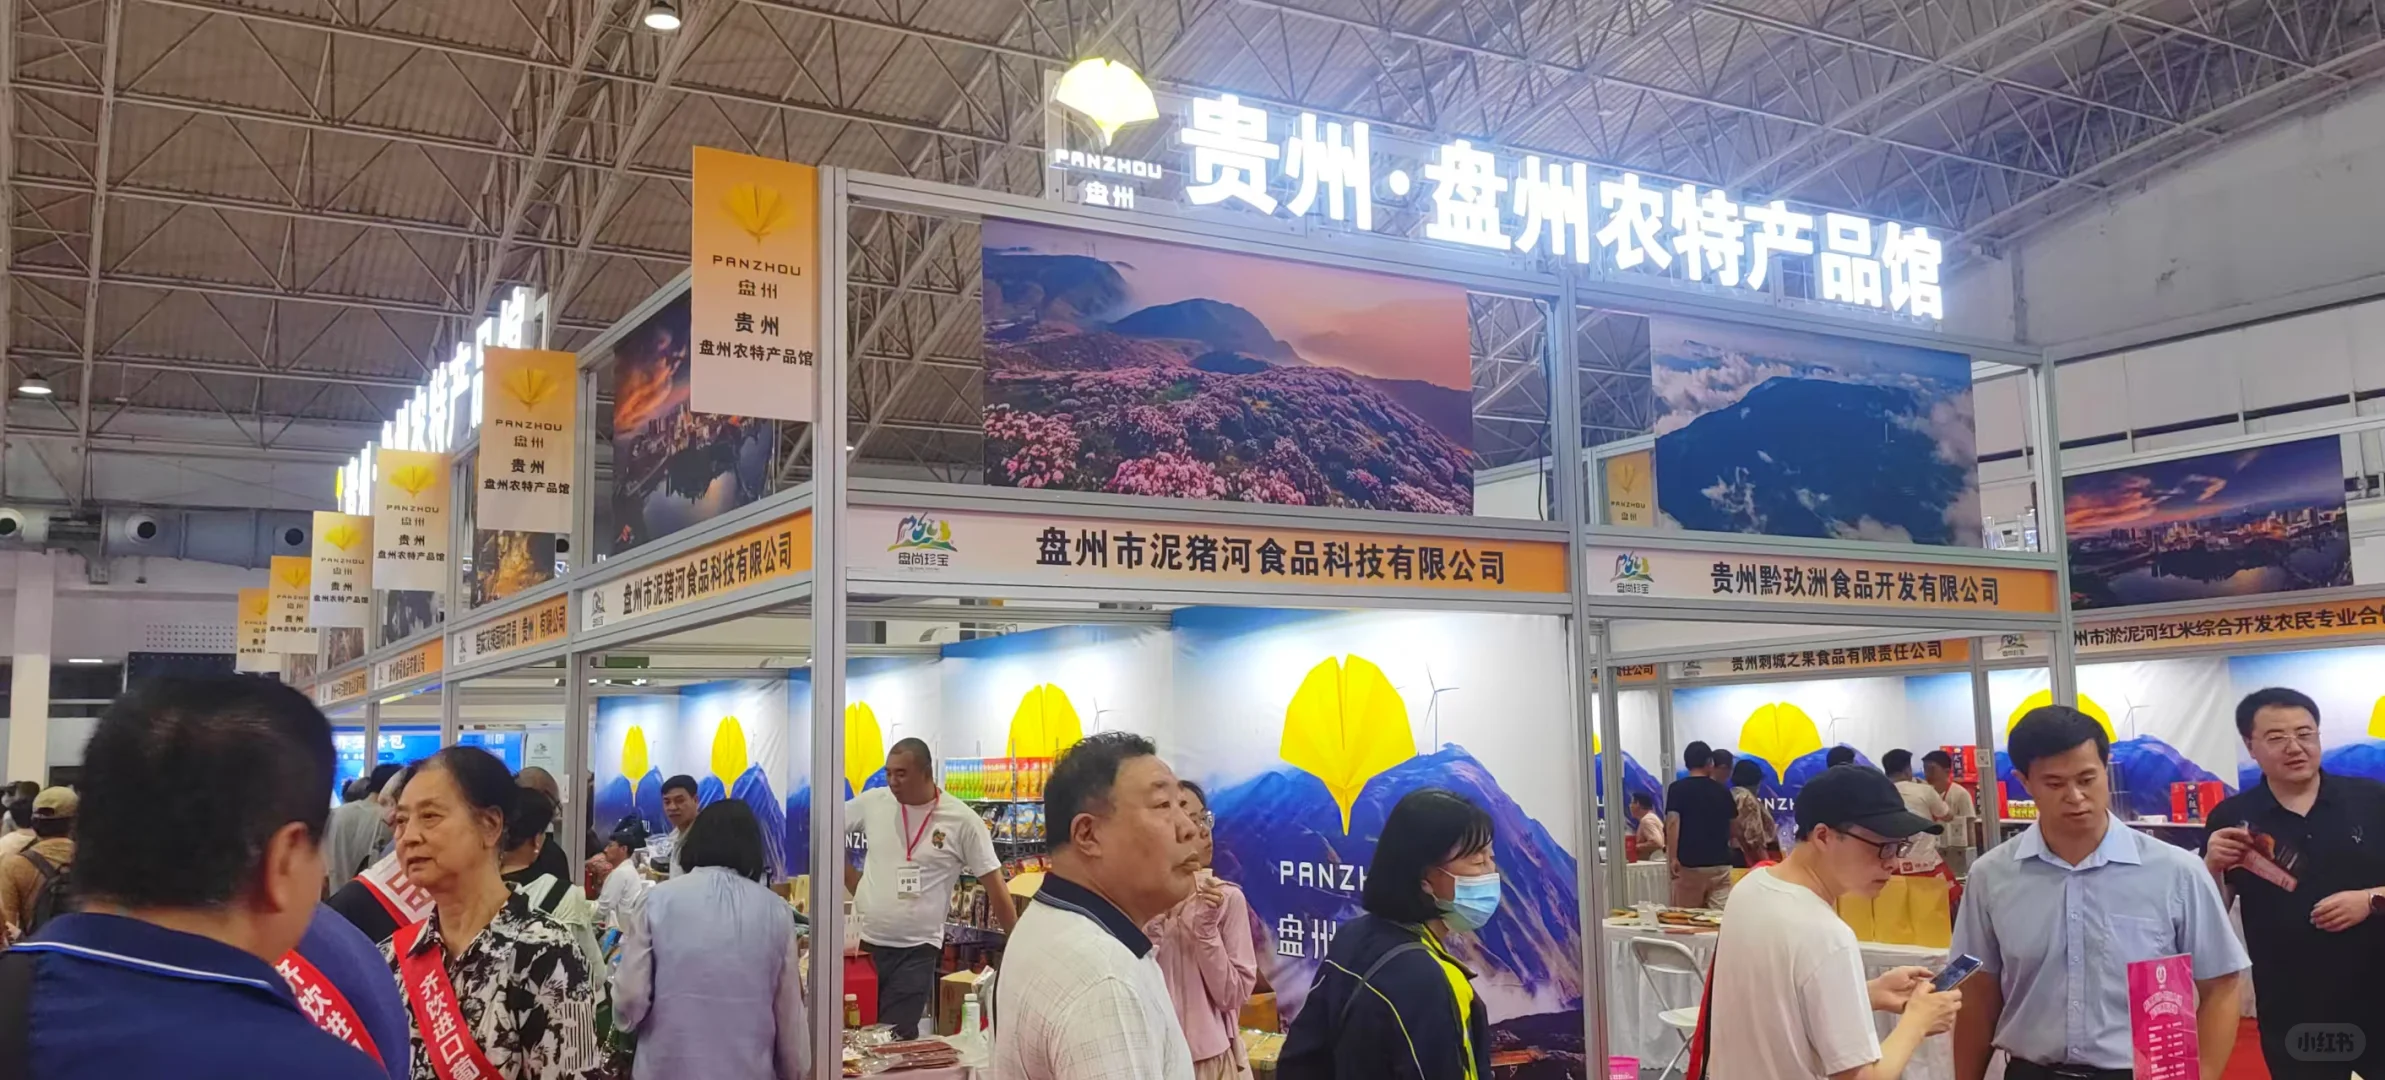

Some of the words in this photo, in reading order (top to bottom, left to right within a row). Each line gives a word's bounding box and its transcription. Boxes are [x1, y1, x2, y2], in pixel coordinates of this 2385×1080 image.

[1055, 148, 1162, 179] PANZHOU
[1085, 181, 1135, 209] 盘州
[1181, 93, 1944, 320] 贵州·盘州农特产品馆
[712, 254, 801, 277] PANZHOU
[738, 279, 778, 299] 盘州
[734, 312, 780, 337] 贵州
[699, 339, 813, 366] 盘州农特产品馆
[495, 419, 562, 432] PANZHOU
[514, 435, 544, 449] 盘州
[511, 458, 545, 475] 贵州
[483, 478, 570, 495] 盘州农特产品馆
[386, 504, 440, 513] PANZHOU
[401, 517, 425, 527] 盘州
[398, 534, 425, 547] 贵州
[377, 549, 446, 562] 盘州农特产品馆
[1036, 526, 1505, 585] 盘州市泥猪河食品科技有限公司
[622, 531, 792, 615] 盘州市泥猪河食品科技有限公司
[1710, 560, 2000, 606] 贵州黔玖洲食品开发有限公司
